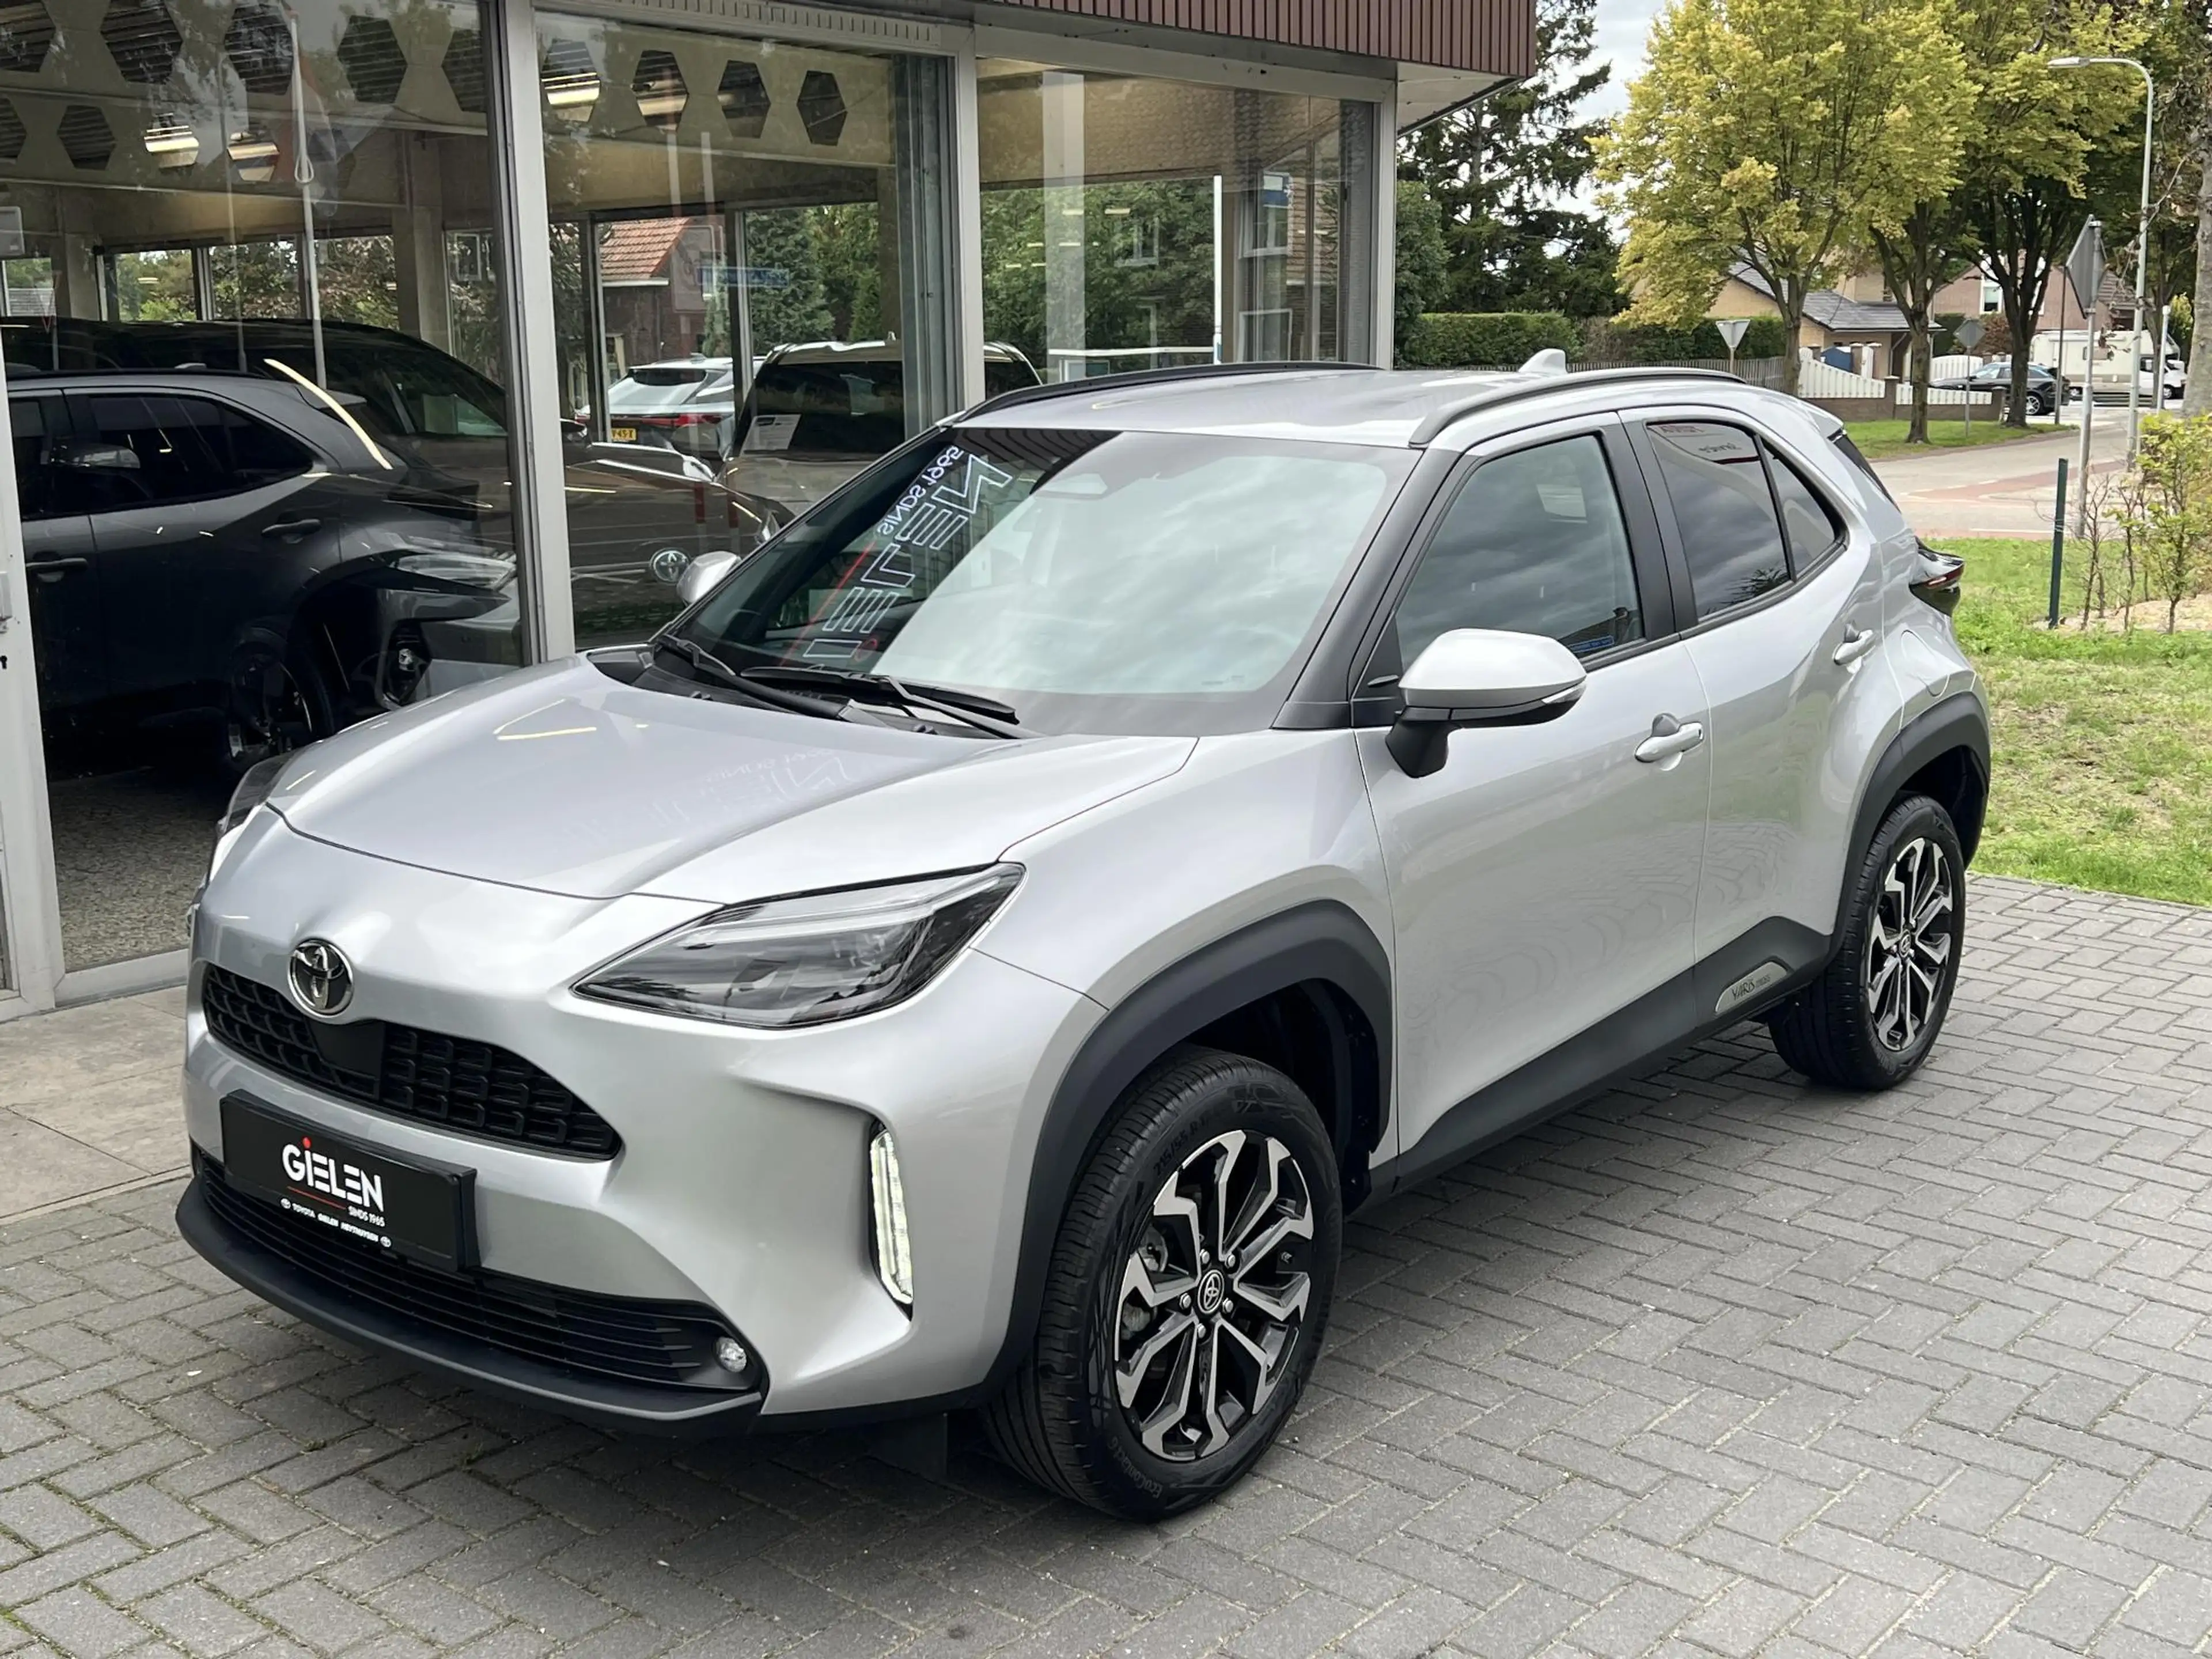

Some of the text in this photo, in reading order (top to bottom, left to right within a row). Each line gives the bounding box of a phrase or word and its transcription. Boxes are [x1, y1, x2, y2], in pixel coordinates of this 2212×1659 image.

[292, 1203, 316, 1218] TOYOTA
[348, 1206, 385, 1227] SINDS 1965
